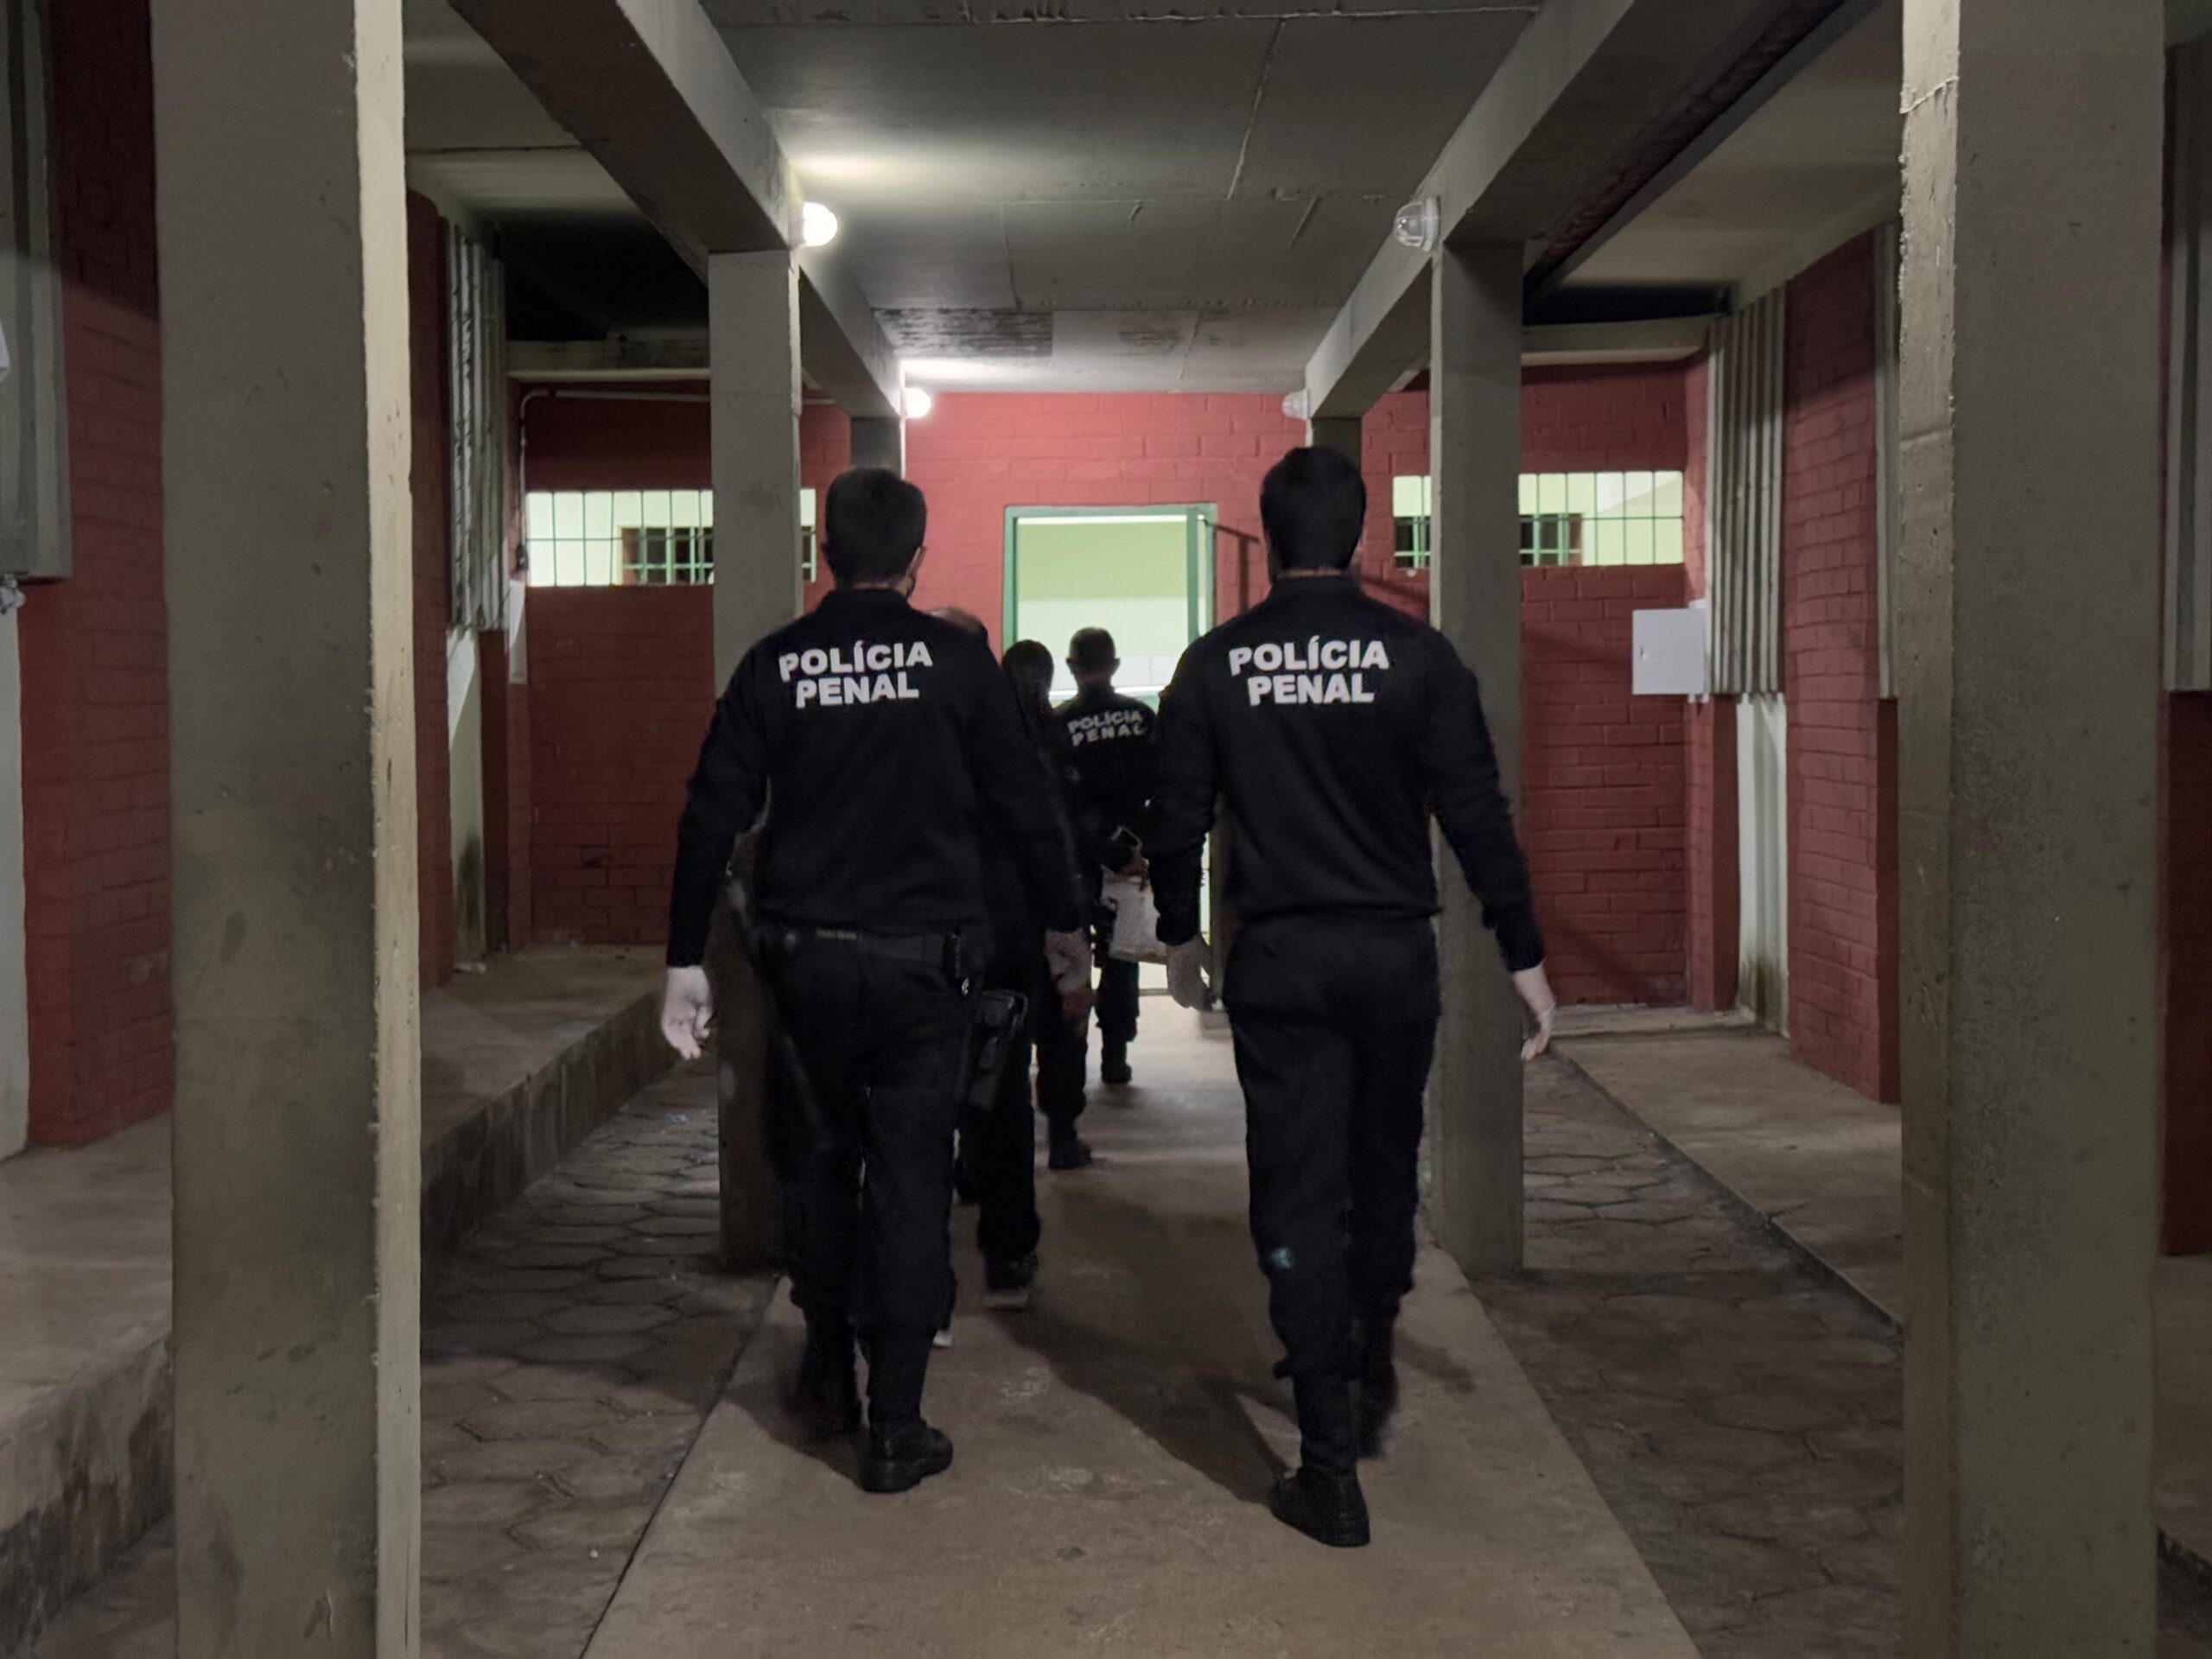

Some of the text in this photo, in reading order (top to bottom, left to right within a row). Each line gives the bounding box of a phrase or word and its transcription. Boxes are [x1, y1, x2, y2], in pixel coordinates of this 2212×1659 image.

[779, 639, 933, 683] POLÍCIA
[1229, 635, 1390, 677] POLÍCIA
[796, 671, 919, 709] PENAL
[1247, 672, 1376, 707] PENAL
[1071, 723, 1147, 747] PENAL
